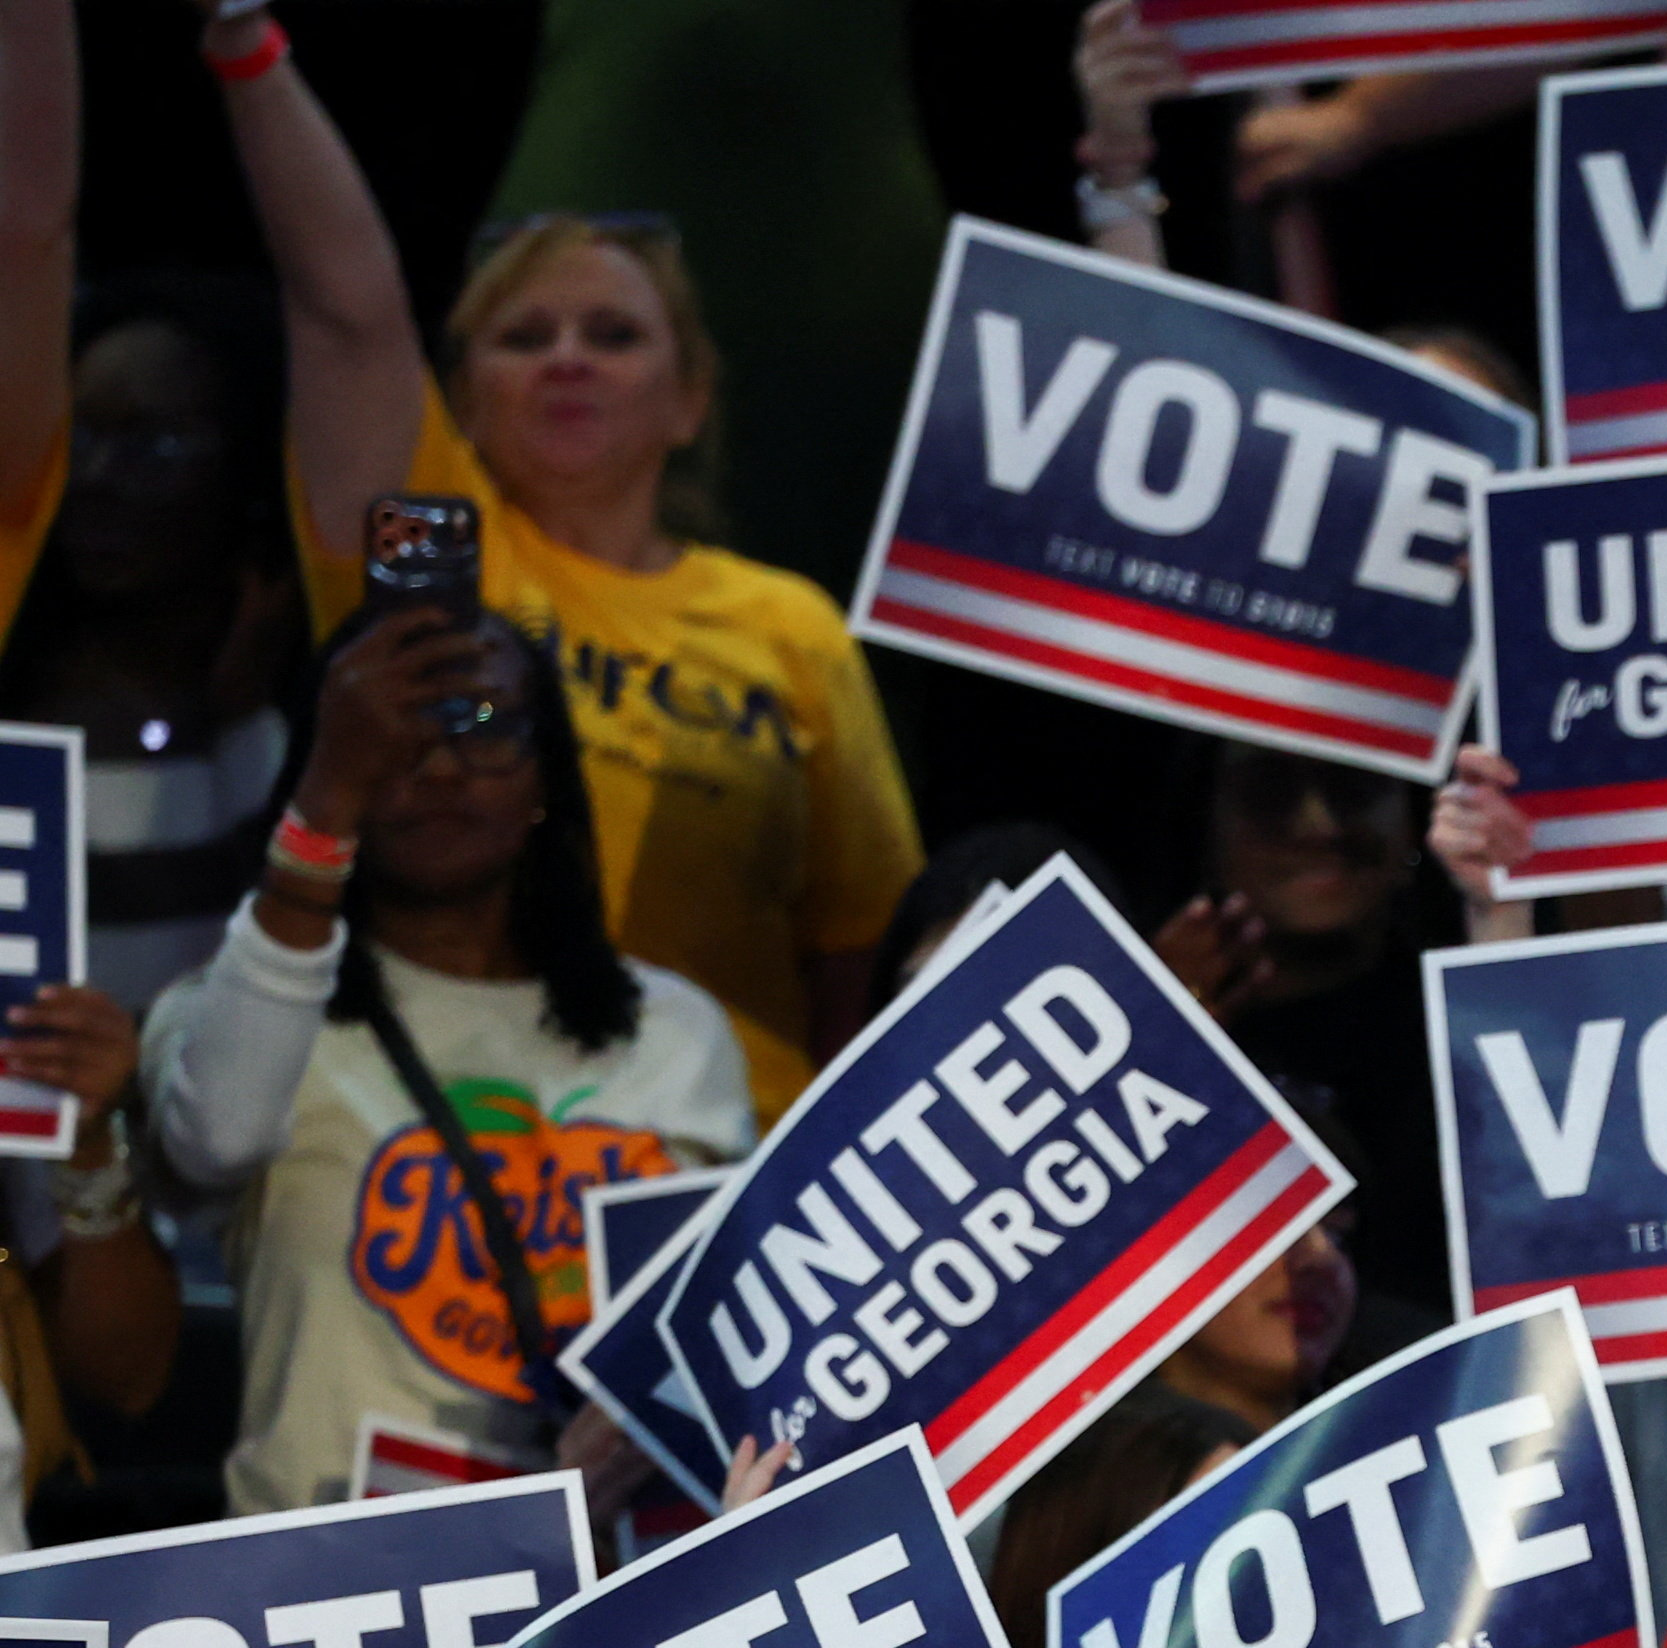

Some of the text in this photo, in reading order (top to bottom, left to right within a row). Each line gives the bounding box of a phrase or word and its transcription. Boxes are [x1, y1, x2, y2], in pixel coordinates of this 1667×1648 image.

[973, 311, 1493, 605] VOTE
[1046, 536, 1113, 575] TEXT
[1121, 552, 1198, 605] VOTE
[1206, 580, 1245, 612] TO
[1552, 679, 1613, 742] for
[366, 1147, 639, 1294] Kis
[710, 964, 1133, 1389] UNITED
[769, 1067, 1210, 1468] for GEORGIA
